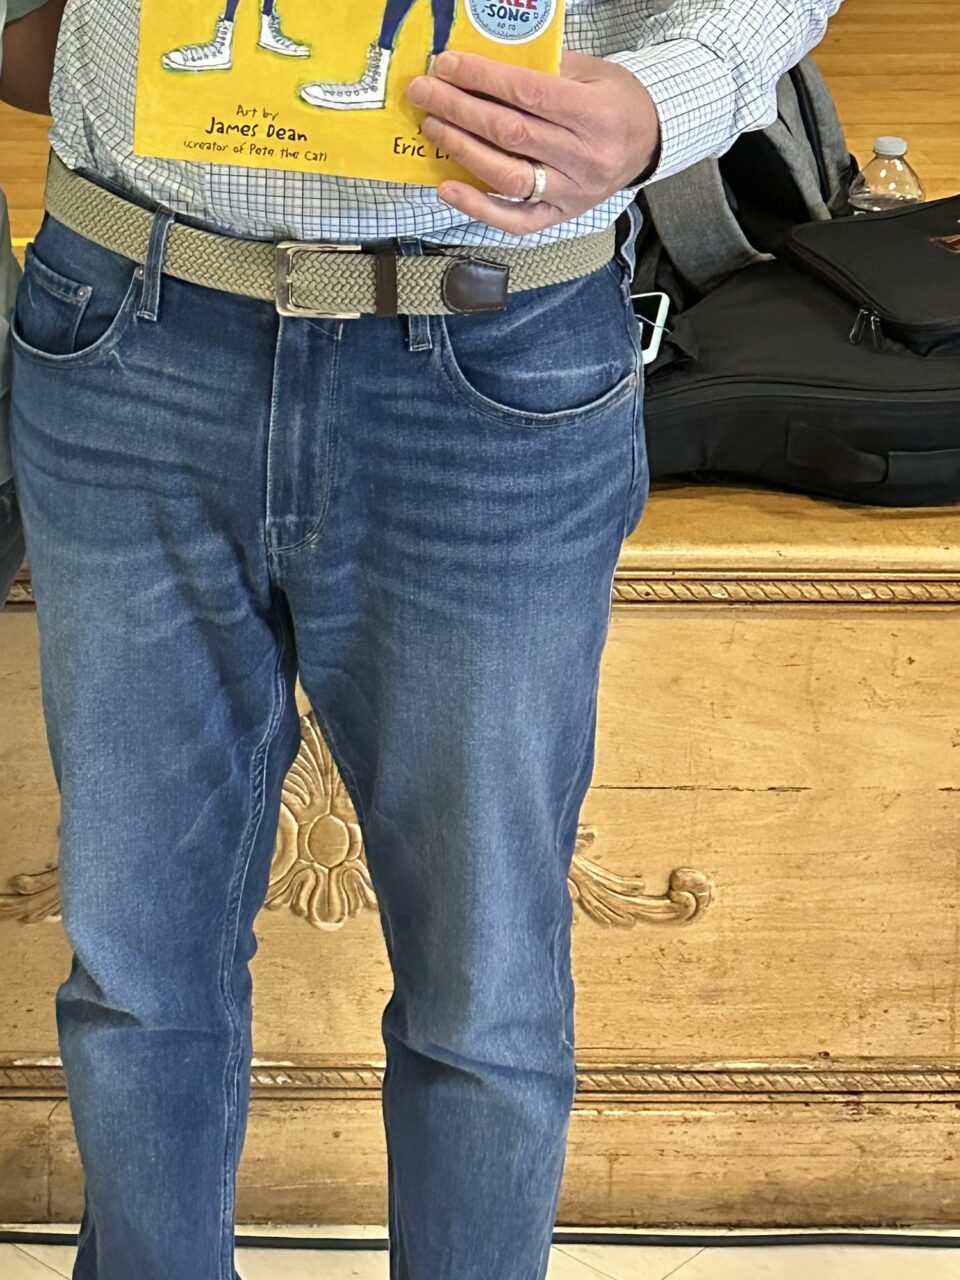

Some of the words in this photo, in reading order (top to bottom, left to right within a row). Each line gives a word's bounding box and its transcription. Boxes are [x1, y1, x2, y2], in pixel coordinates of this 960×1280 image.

[487, 3, 531, 23] SONG
[236, 104, 258, 118] Art
[262, 107, 280, 121] by
[205, 116, 259, 137] James
[266, 124, 308, 142] Dean
[233, 141, 248, 154] of
[249, 143, 275, 157] Pete
[280, 147, 300, 160] the
[393, 136, 427, 158] Eric
